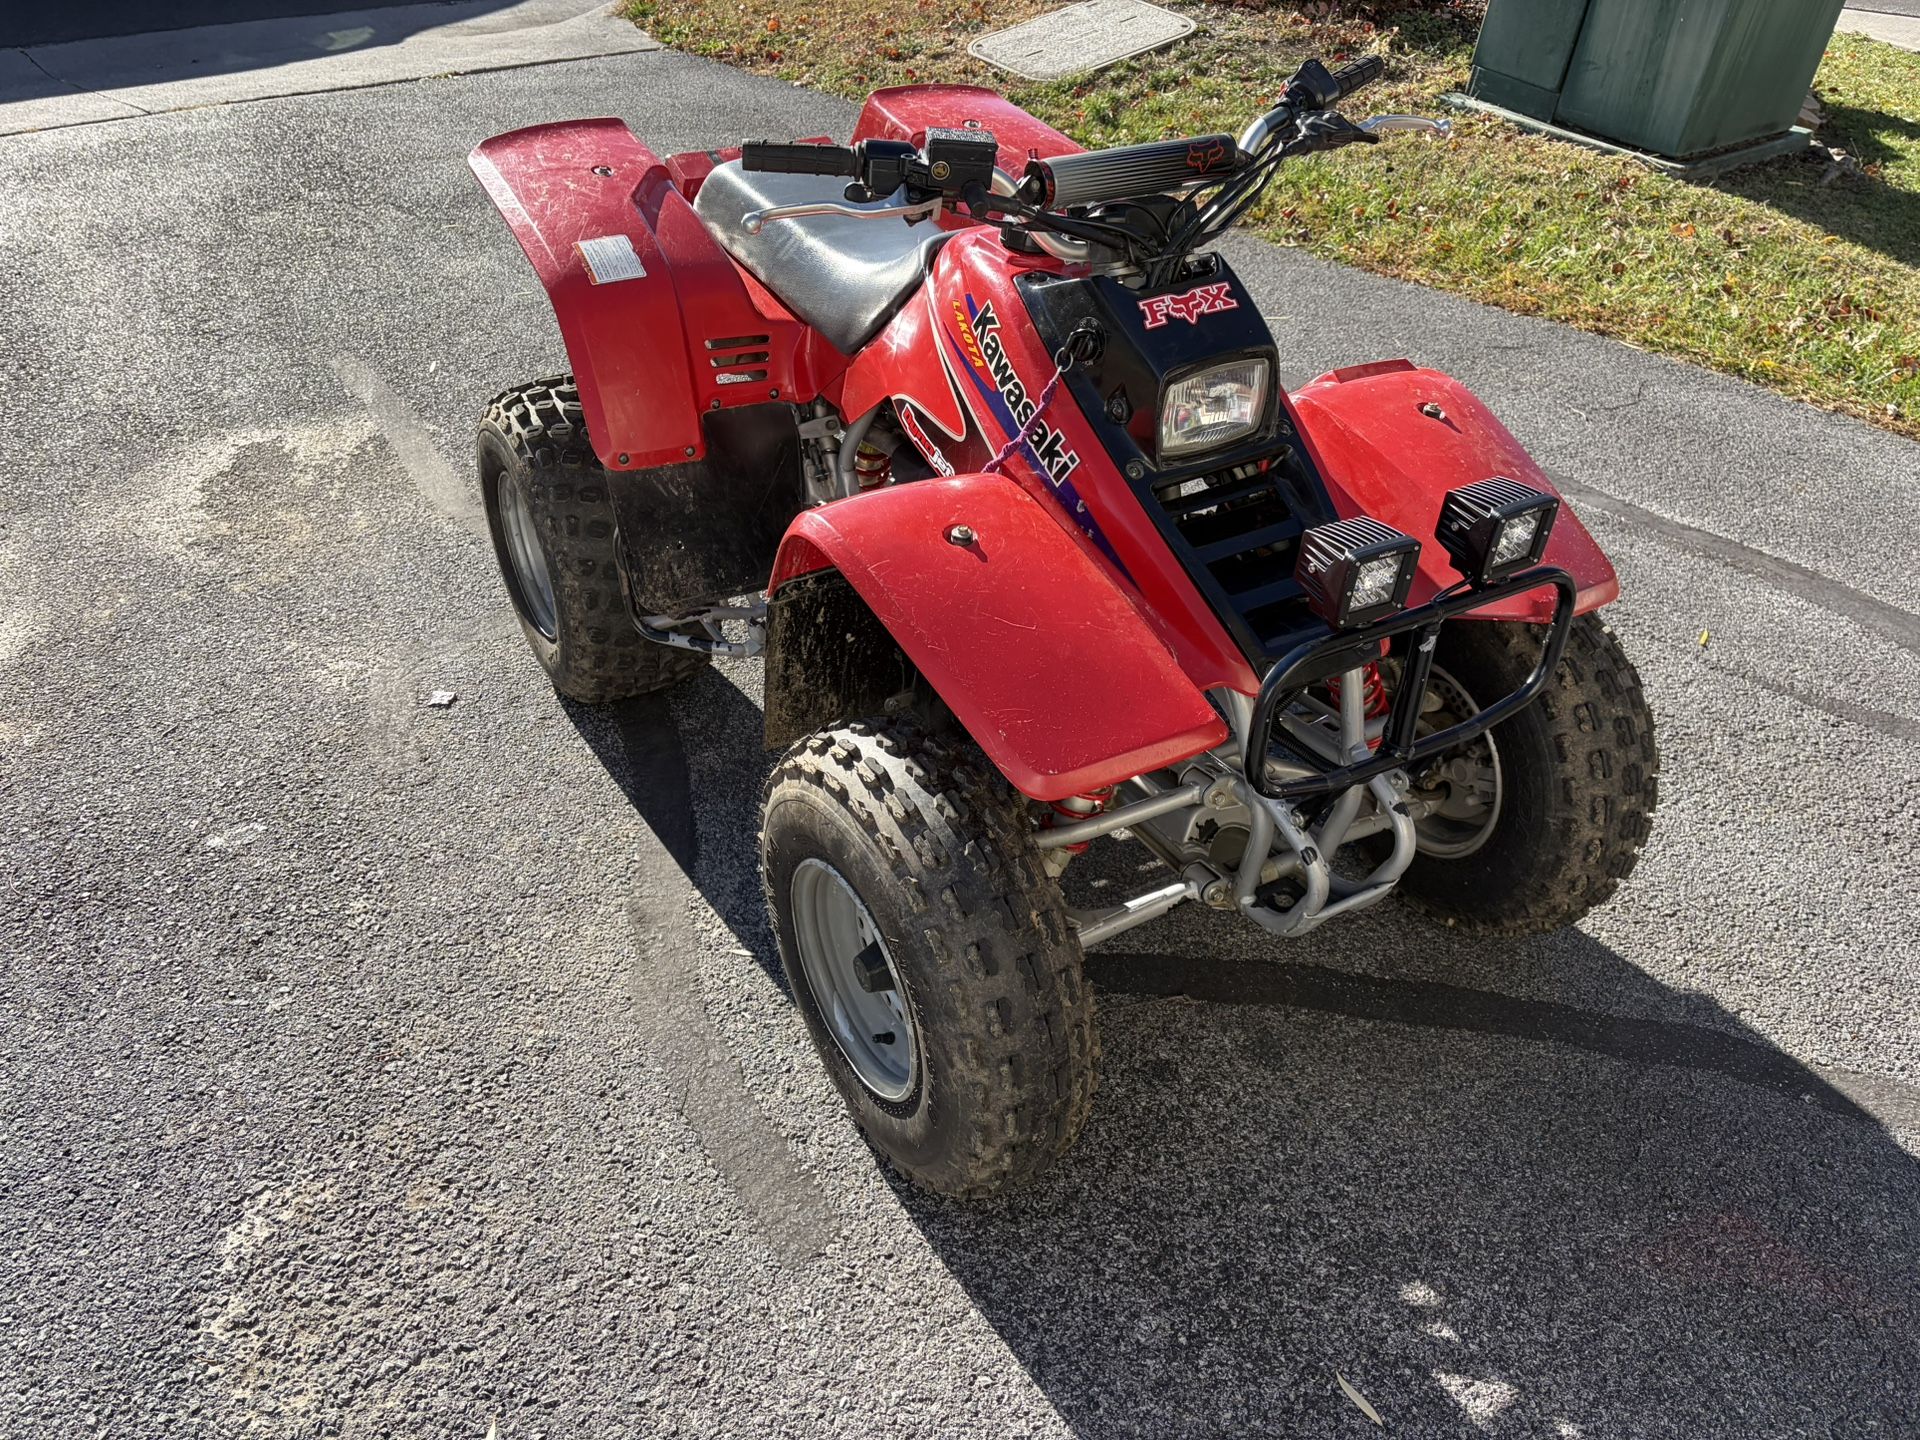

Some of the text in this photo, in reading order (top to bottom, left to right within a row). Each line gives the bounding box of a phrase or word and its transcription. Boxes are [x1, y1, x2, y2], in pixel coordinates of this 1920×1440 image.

[953, 301, 984, 367] LAKOTA
[1139, 282, 1238, 328] FOX
[972, 300, 1080, 486] Kawasaki
